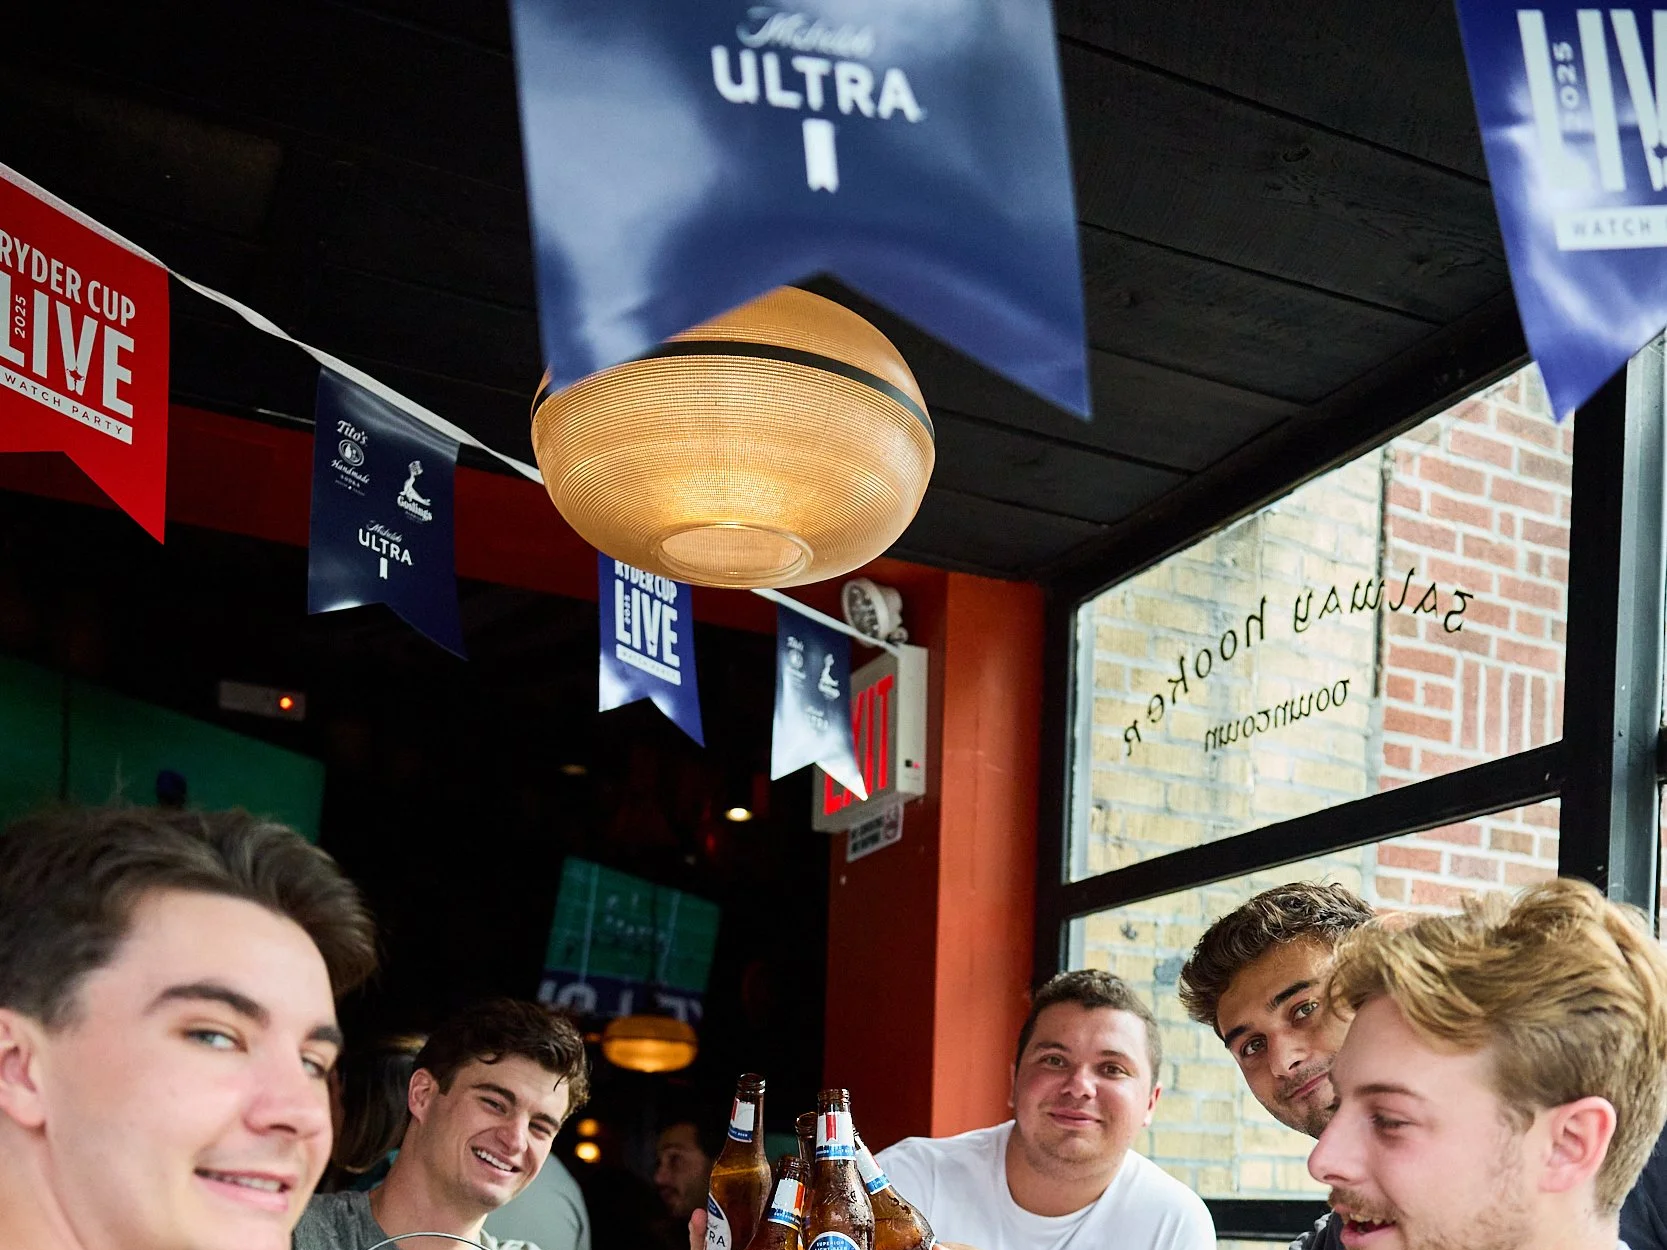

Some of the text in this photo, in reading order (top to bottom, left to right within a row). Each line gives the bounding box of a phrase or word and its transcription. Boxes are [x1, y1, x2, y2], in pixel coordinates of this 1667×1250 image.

[711, 45, 926, 123] ULTRA
[1572, 216, 1652, 238] WATCH
[0, 229, 136, 328] RYDER CUP
[14, 294, 27, 339] 2025
[0, 270, 135, 419] LIVE
[4, 372, 123, 435] WATCH PARTY
[337, 420, 368, 445] Tito's
[331, 459, 370, 484] Handmade
[358, 528, 413, 566] ULTRA
[654, 575, 678, 605] CUP
[614, 578, 680, 668] LIVE
